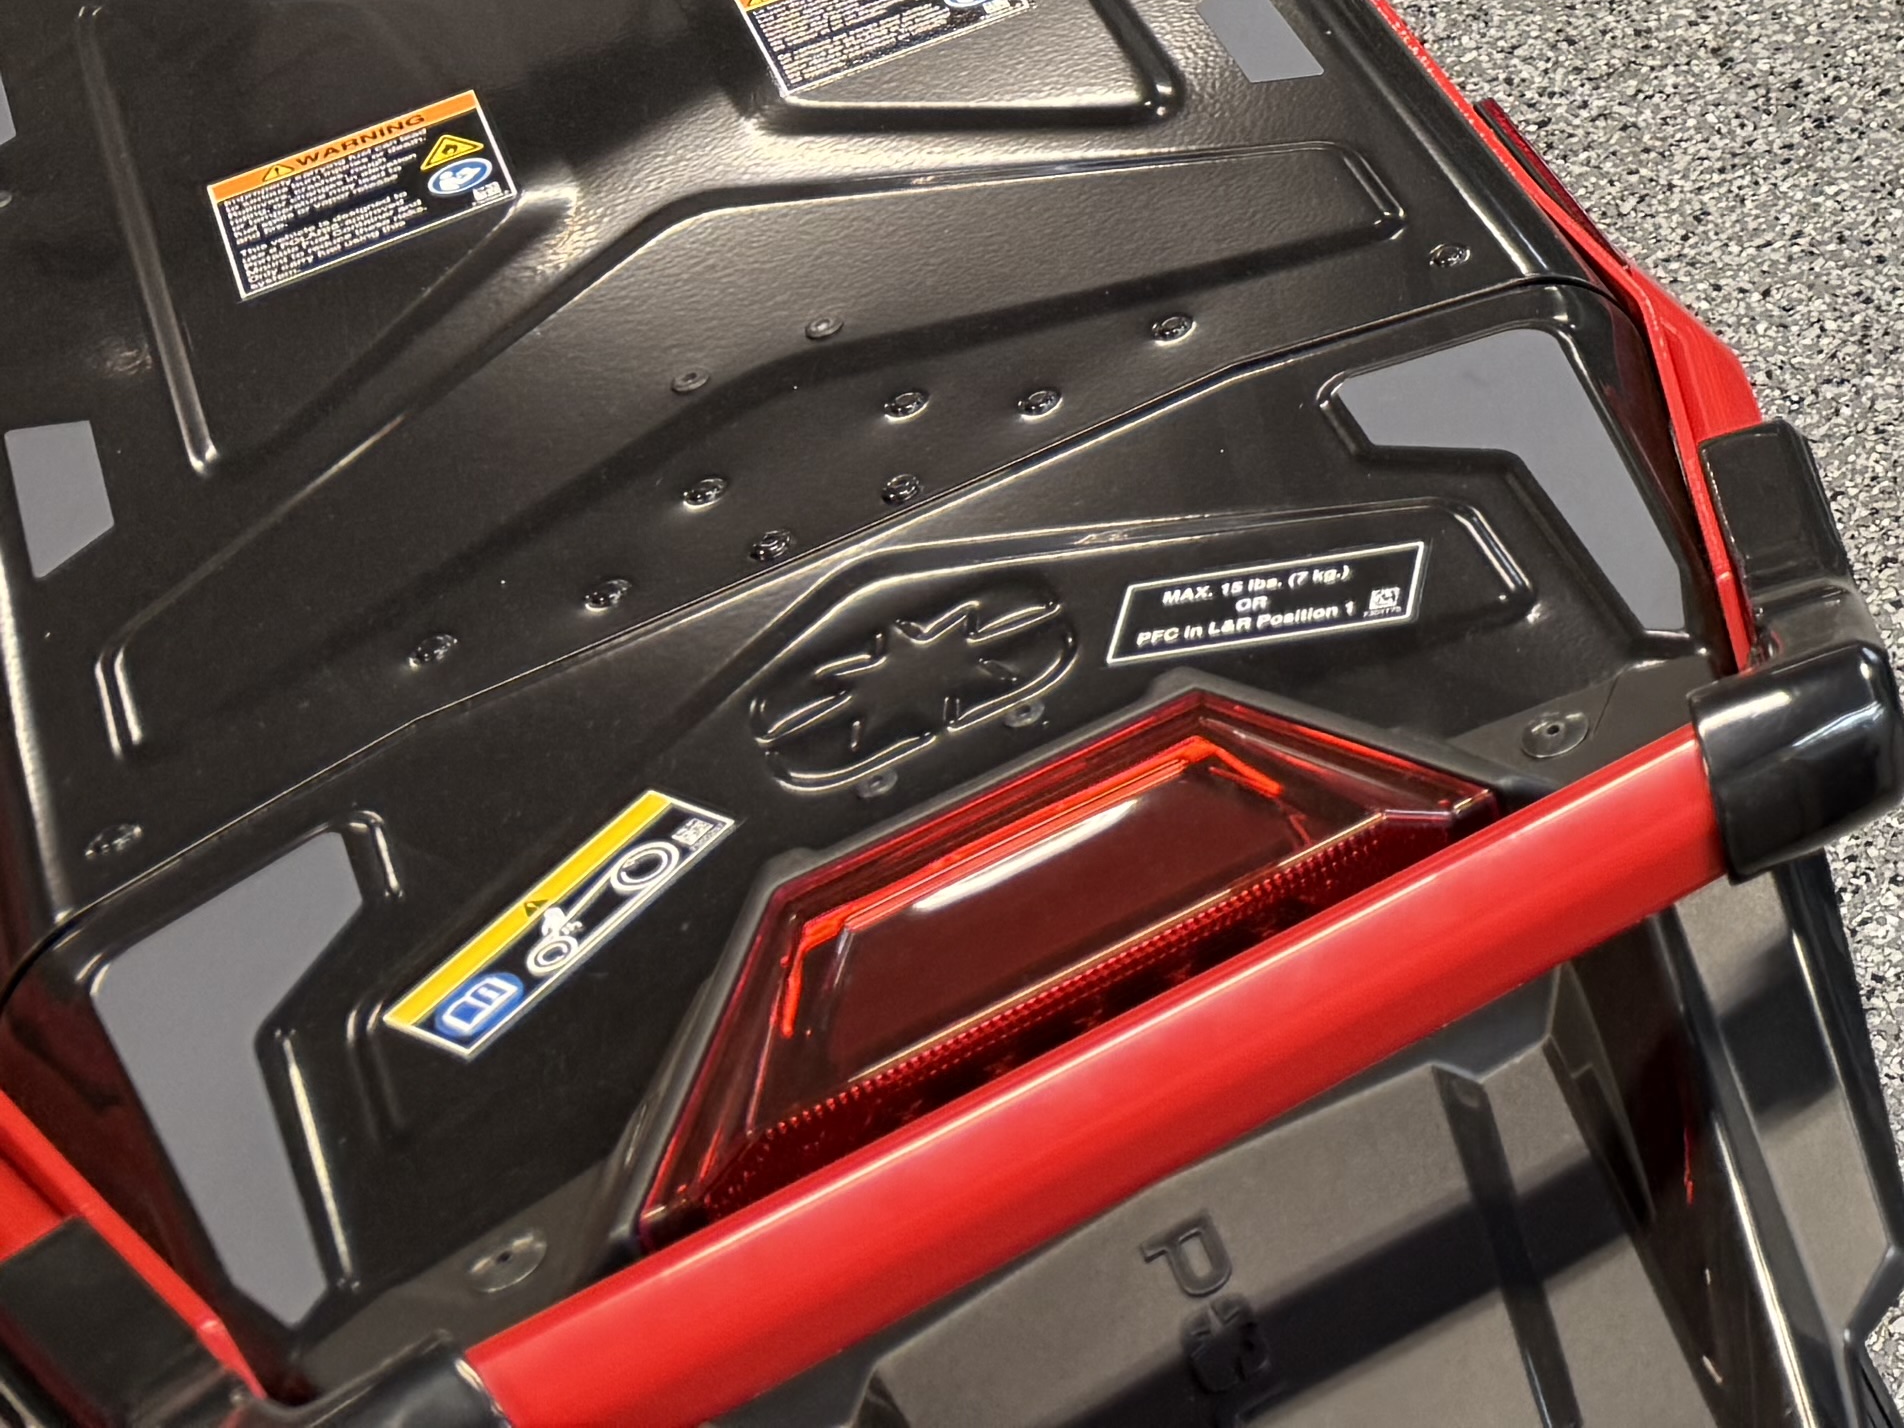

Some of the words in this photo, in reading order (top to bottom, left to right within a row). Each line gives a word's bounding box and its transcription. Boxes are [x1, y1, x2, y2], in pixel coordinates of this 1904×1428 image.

[295, 113, 426, 167] WARNING
[1162, 586, 1214, 606] MAX.
[1221, 580, 1246, 597] 15
[1248, 576, 1283, 594] lbs.
[1287, 571, 1305, 589] (7
[1313, 564, 1351, 583] kg.)
[1234, 595, 1269, 613] OR
[1136, 626, 1180, 647] PFC
[1208, 617, 1252, 637] L&R
[1255, 604, 1339, 630] Position
[1344, 600, 1356, 617] 1
